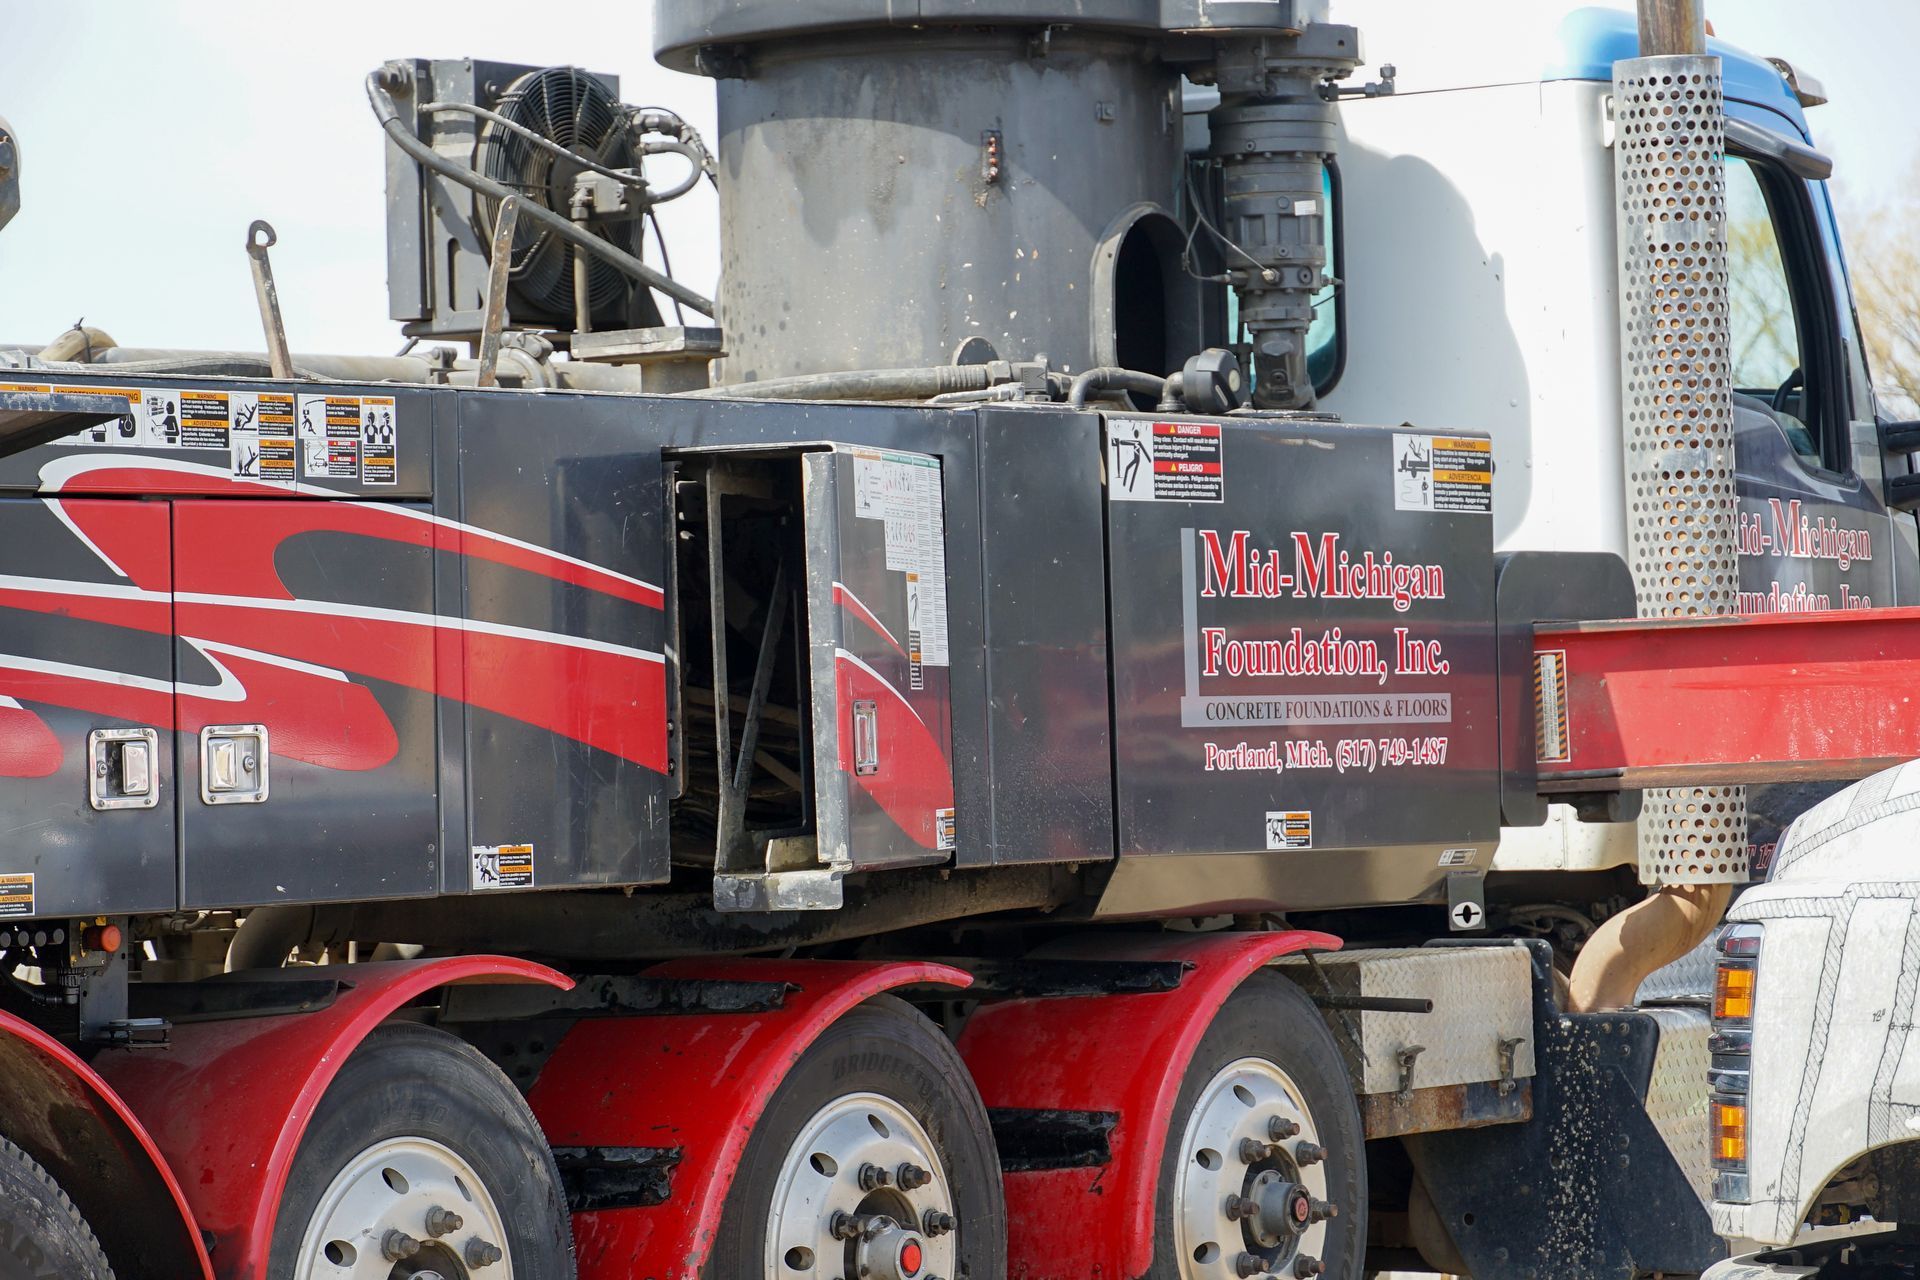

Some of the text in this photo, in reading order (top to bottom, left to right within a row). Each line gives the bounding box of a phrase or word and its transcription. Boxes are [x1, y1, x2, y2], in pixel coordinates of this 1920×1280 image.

[1177, 426, 1201, 434] DANGER
[1178, 464, 1203, 472] PELIGRO
[1449, 473, 1482, 481] ADVERTENCIA
[1736, 496, 1873, 571] id-Michigan
[1199, 530, 1446, 612] Mid-Michigan
[1202, 627, 1450, 685] Foundation, Inc.
[1206, 698, 1448, 721] CONCRETE FOUNDATIONS & FLOORS
[1204, 737, 1448, 774] Portland, Mich. (517) 749-1487
